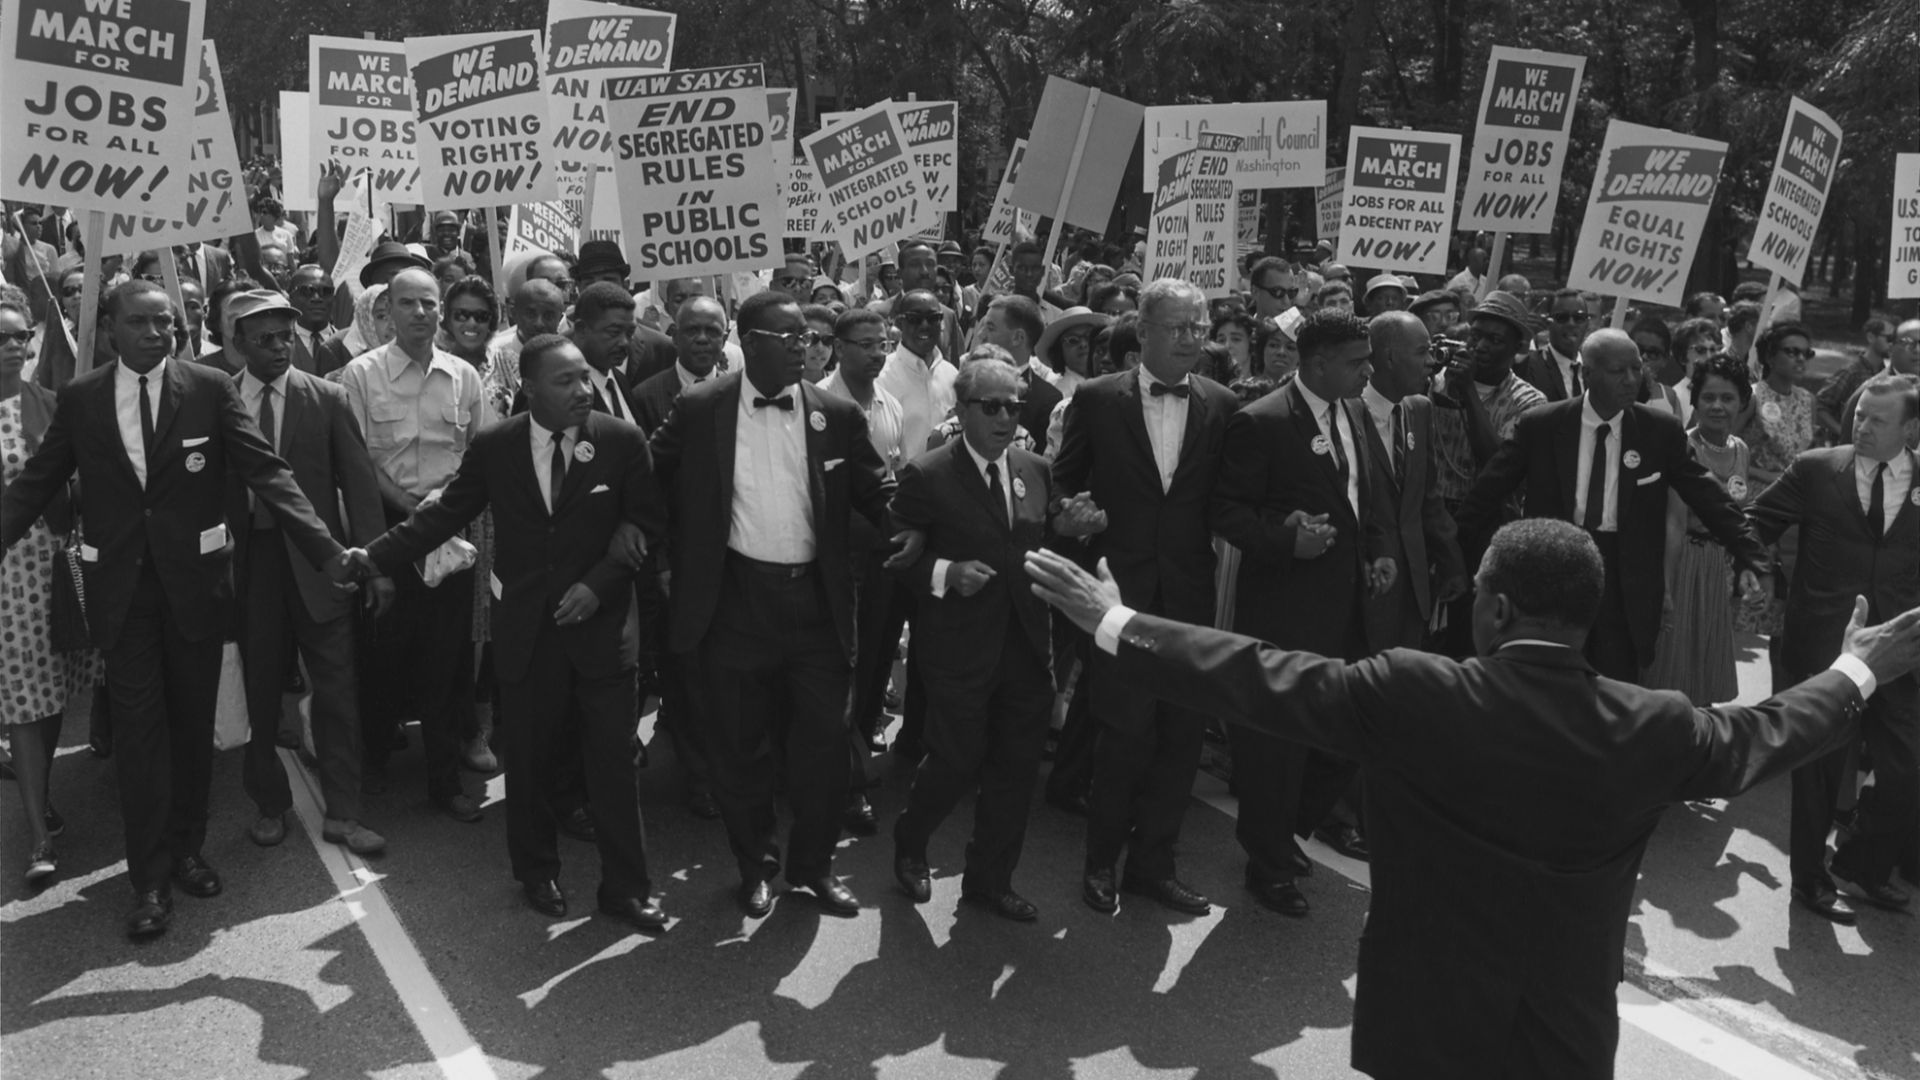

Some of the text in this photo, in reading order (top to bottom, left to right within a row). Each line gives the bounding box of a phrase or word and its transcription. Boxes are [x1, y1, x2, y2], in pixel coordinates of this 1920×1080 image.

[84, 0, 131, 19] WE
[30, 8, 175, 60] MARCH
[587, 18, 632, 41] WE
[75, 50, 130, 73] FOR
[358, 55, 390, 72] WE
[452, 46, 495, 78] WE
[554, 40, 662, 68] DEMAND
[424, 61, 534, 113] DEMAND
[552, 77, 589, 98] AN
[614, 76, 671, 97] UAW
[676, 67, 758, 92] SAYS:
[1525, 68, 1548, 87] WE
[25, 80, 167, 132] JOBS
[356, 95, 392, 107] FOR
[637, 97, 736, 128] END
[1495, 87, 1565, 113] MARCH
[327, 117, 416, 144] JOBS
[429, 114, 540, 141] VOTING
[902, 109, 930, 129] WE
[1514, 113, 1540, 126] FOR
[27, 123, 160, 156] FOR ALL
[618, 122, 764, 160] SEGREGATED
[836, 125, 863, 147] WE
[1276, 116, 1320, 149] Council
[1812, 125, 1827, 148] WE
[330, 145, 415, 160] FOR ALL
[441, 140, 539, 167] RIGHTS
[823, 131, 891, 174] MARCH
[914, 153, 952, 167] FEPC
[1390, 143, 1417, 158] WE
[1485, 138, 1553, 167] JOBS
[1645, 149, 1691, 171] WE
[1789, 137, 1830, 177] MARCH
[18, 153, 169, 202] NOW!
[443, 161, 542, 196] NOW!
[641, 153, 745, 186] RULES
[848, 157, 875, 174] FOR
[1199, 156, 1228, 175] END
[1361, 157, 1442, 180] MARCH
[1483, 171, 1545, 184] FOR ALL
[1800, 165, 1816, 182] FOR
[829, 160, 909, 207] INTEGRATED
[1191, 179, 1233, 199] SEGREGATED
[1384, 178, 1415, 188] FOR
[1607, 173, 1713, 197] DEMAND
[1774, 174, 1822, 217] INTEGRATED
[676, 189, 715, 206] IN
[837, 180, 916, 226] SCHOOLS
[1349, 195, 1444, 214] JOBS FOR ALL
[1473, 191, 1548, 219] NOW!
[643, 203, 760, 236] PUBLIC
[852, 199, 918, 249] NOW!
[1196, 204, 1224, 223] RULES
[1345, 214, 1358, 226] A
[1359, 216, 1412, 231] DECENT
[1414, 220, 1443, 233] PAY
[1608, 206, 1685, 240] EQUAL
[1766, 202, 1813, 242] SCHOOLS
[1203, 231, 1214, 240] IN
[1599, 229, 1683, 265] RIGHTS
[640, 232, 769, 268] SCHOOLS
[1193, 245, 1224, 266] PUBLIC
[1352, 237, 1436, 262] NOW!
[1761, 232, 1807, 270] NOW!
[1190, 268, 1224, 290] SCHOOLS
[1589, 257, 1679, 294] NOW!
